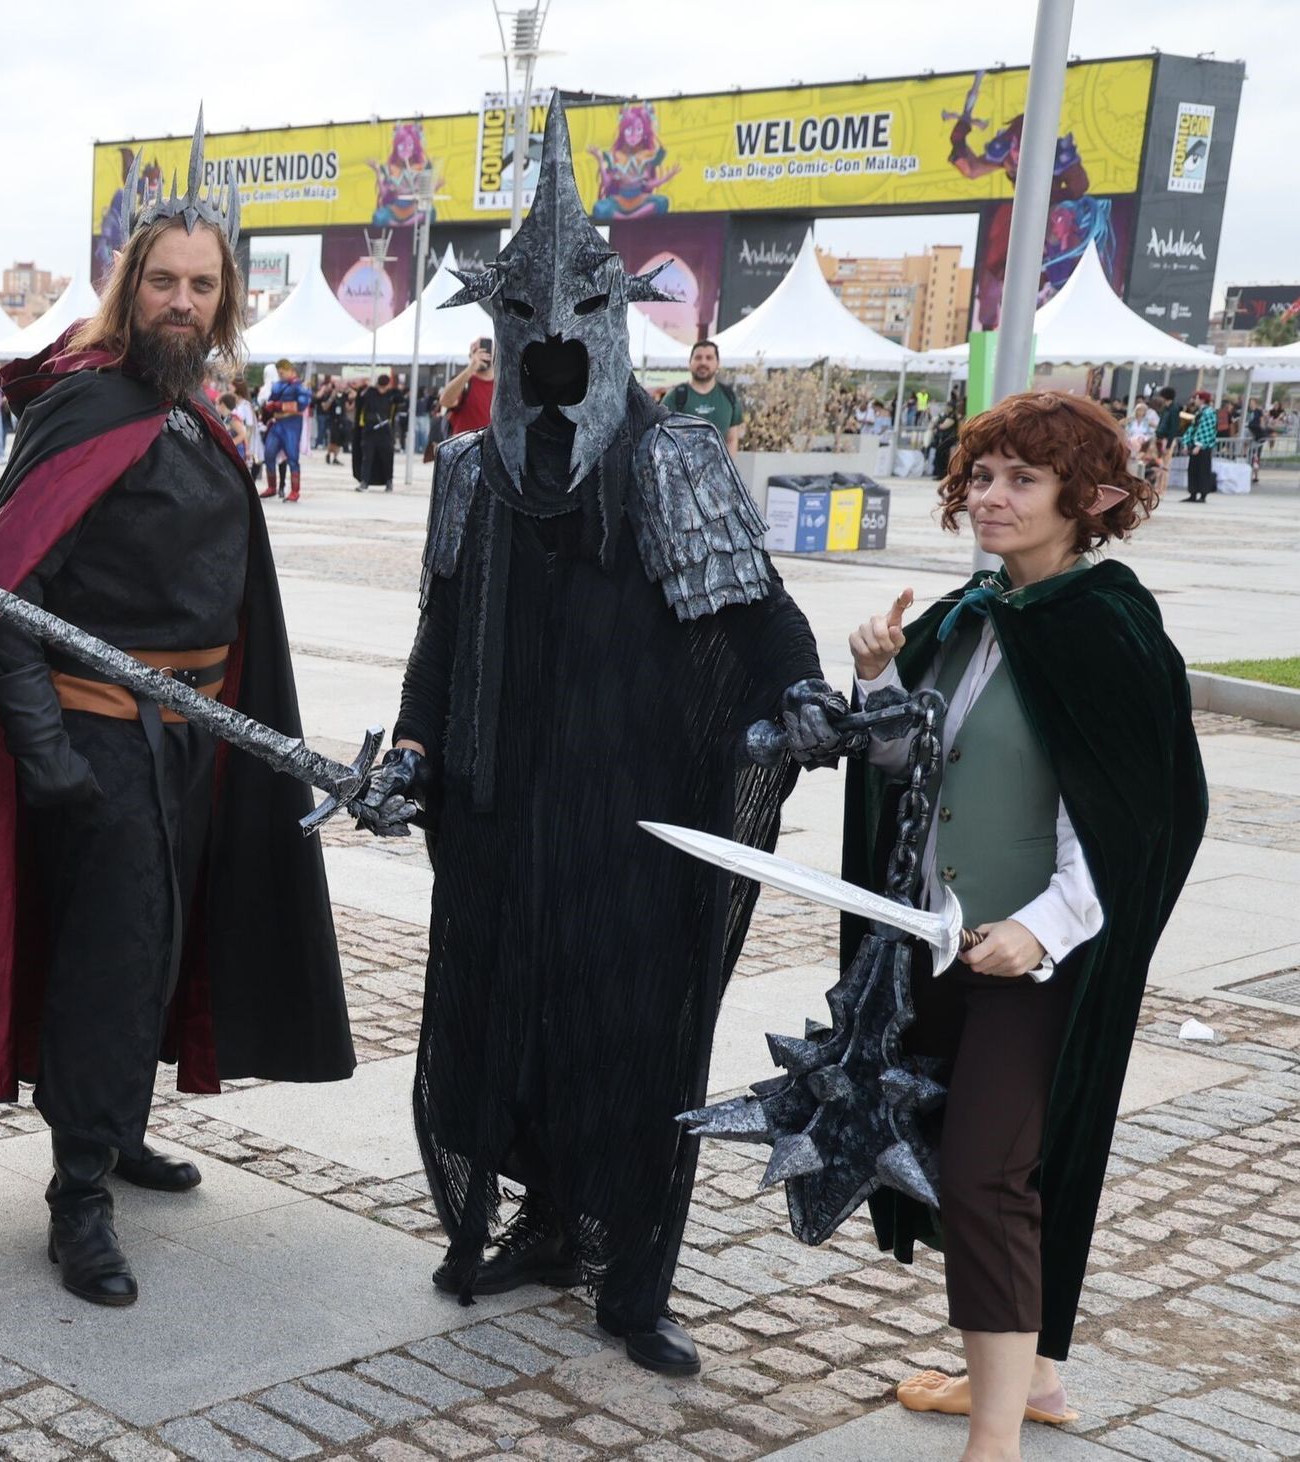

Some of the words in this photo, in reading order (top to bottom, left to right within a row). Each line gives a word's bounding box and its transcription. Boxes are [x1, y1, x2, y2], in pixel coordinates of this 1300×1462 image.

[480, 110, 506, 191] COMIC
[736, 114, 890, 155] WELCOME
[1172, 113, 1191, 177] COMIC
[204, 152, 337, 186] BIENVENIDOS
[705, 169, 716, 179] to
[720, 165, 742, 178] San
[747, 163, 783, 178] Diego
[787, 159, 860, 174] Comic-Con
[250, 258, 282, 270] nisur
